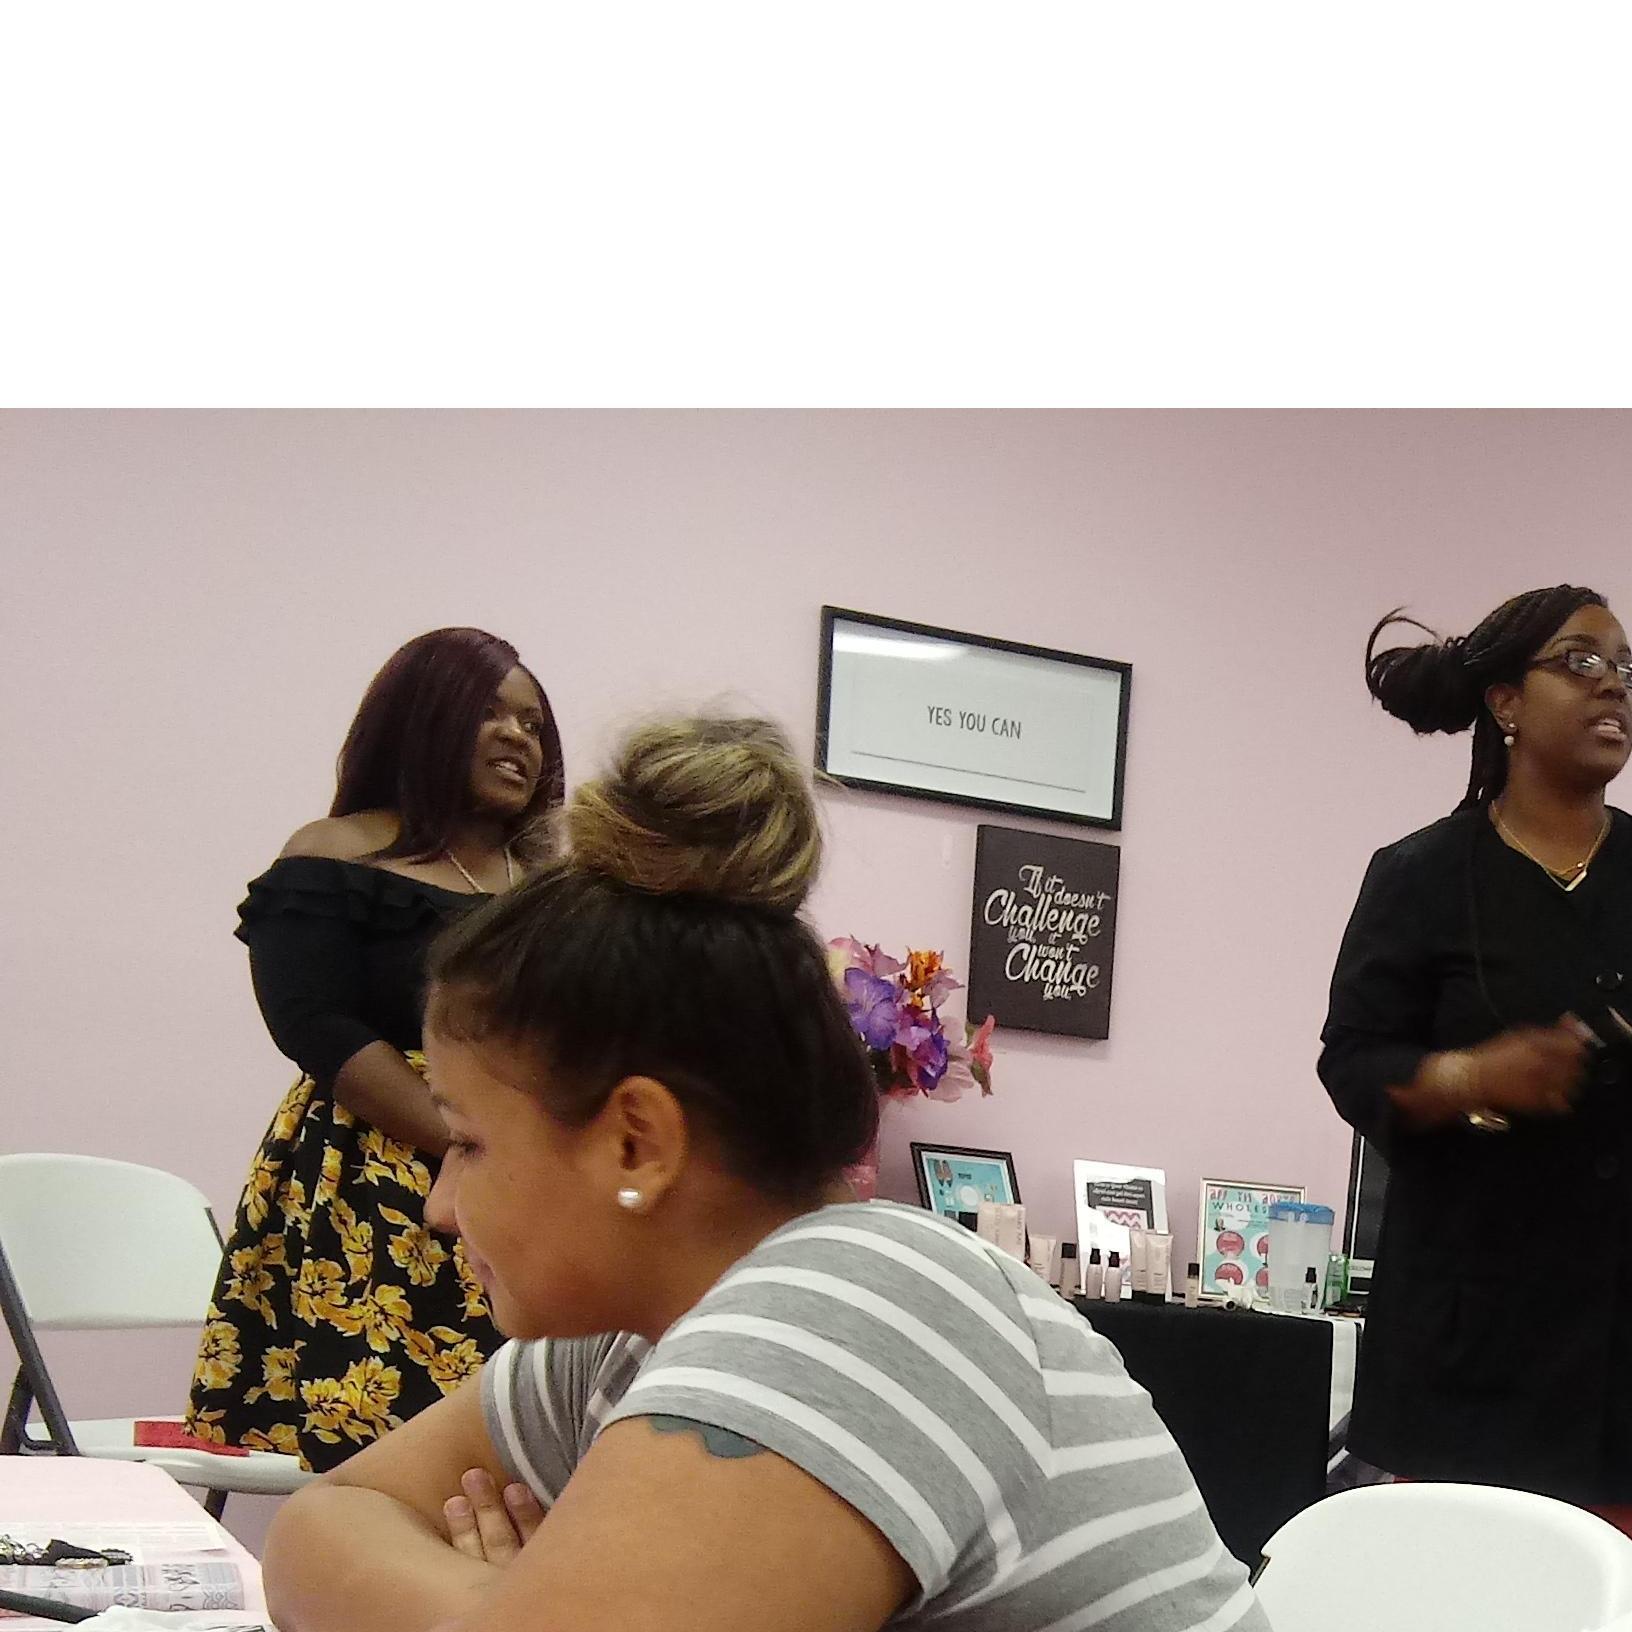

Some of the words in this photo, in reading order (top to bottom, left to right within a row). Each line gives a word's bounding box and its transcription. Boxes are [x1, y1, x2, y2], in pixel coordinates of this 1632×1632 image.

[927, 705, 952, 727] YES
[959, 710, 987, 733] YOU
[991, 717, 1022, 740] CAN
[1018, 864, 1044, 899] If
[1044, 874, 1064, 893] it
[1053, 885, 1112, 911] doesn't
[984, 888, 1101, 945] Challenge
[1004, 942, 1100, 996] Change
[1037, 942, 1081, 962] won't
